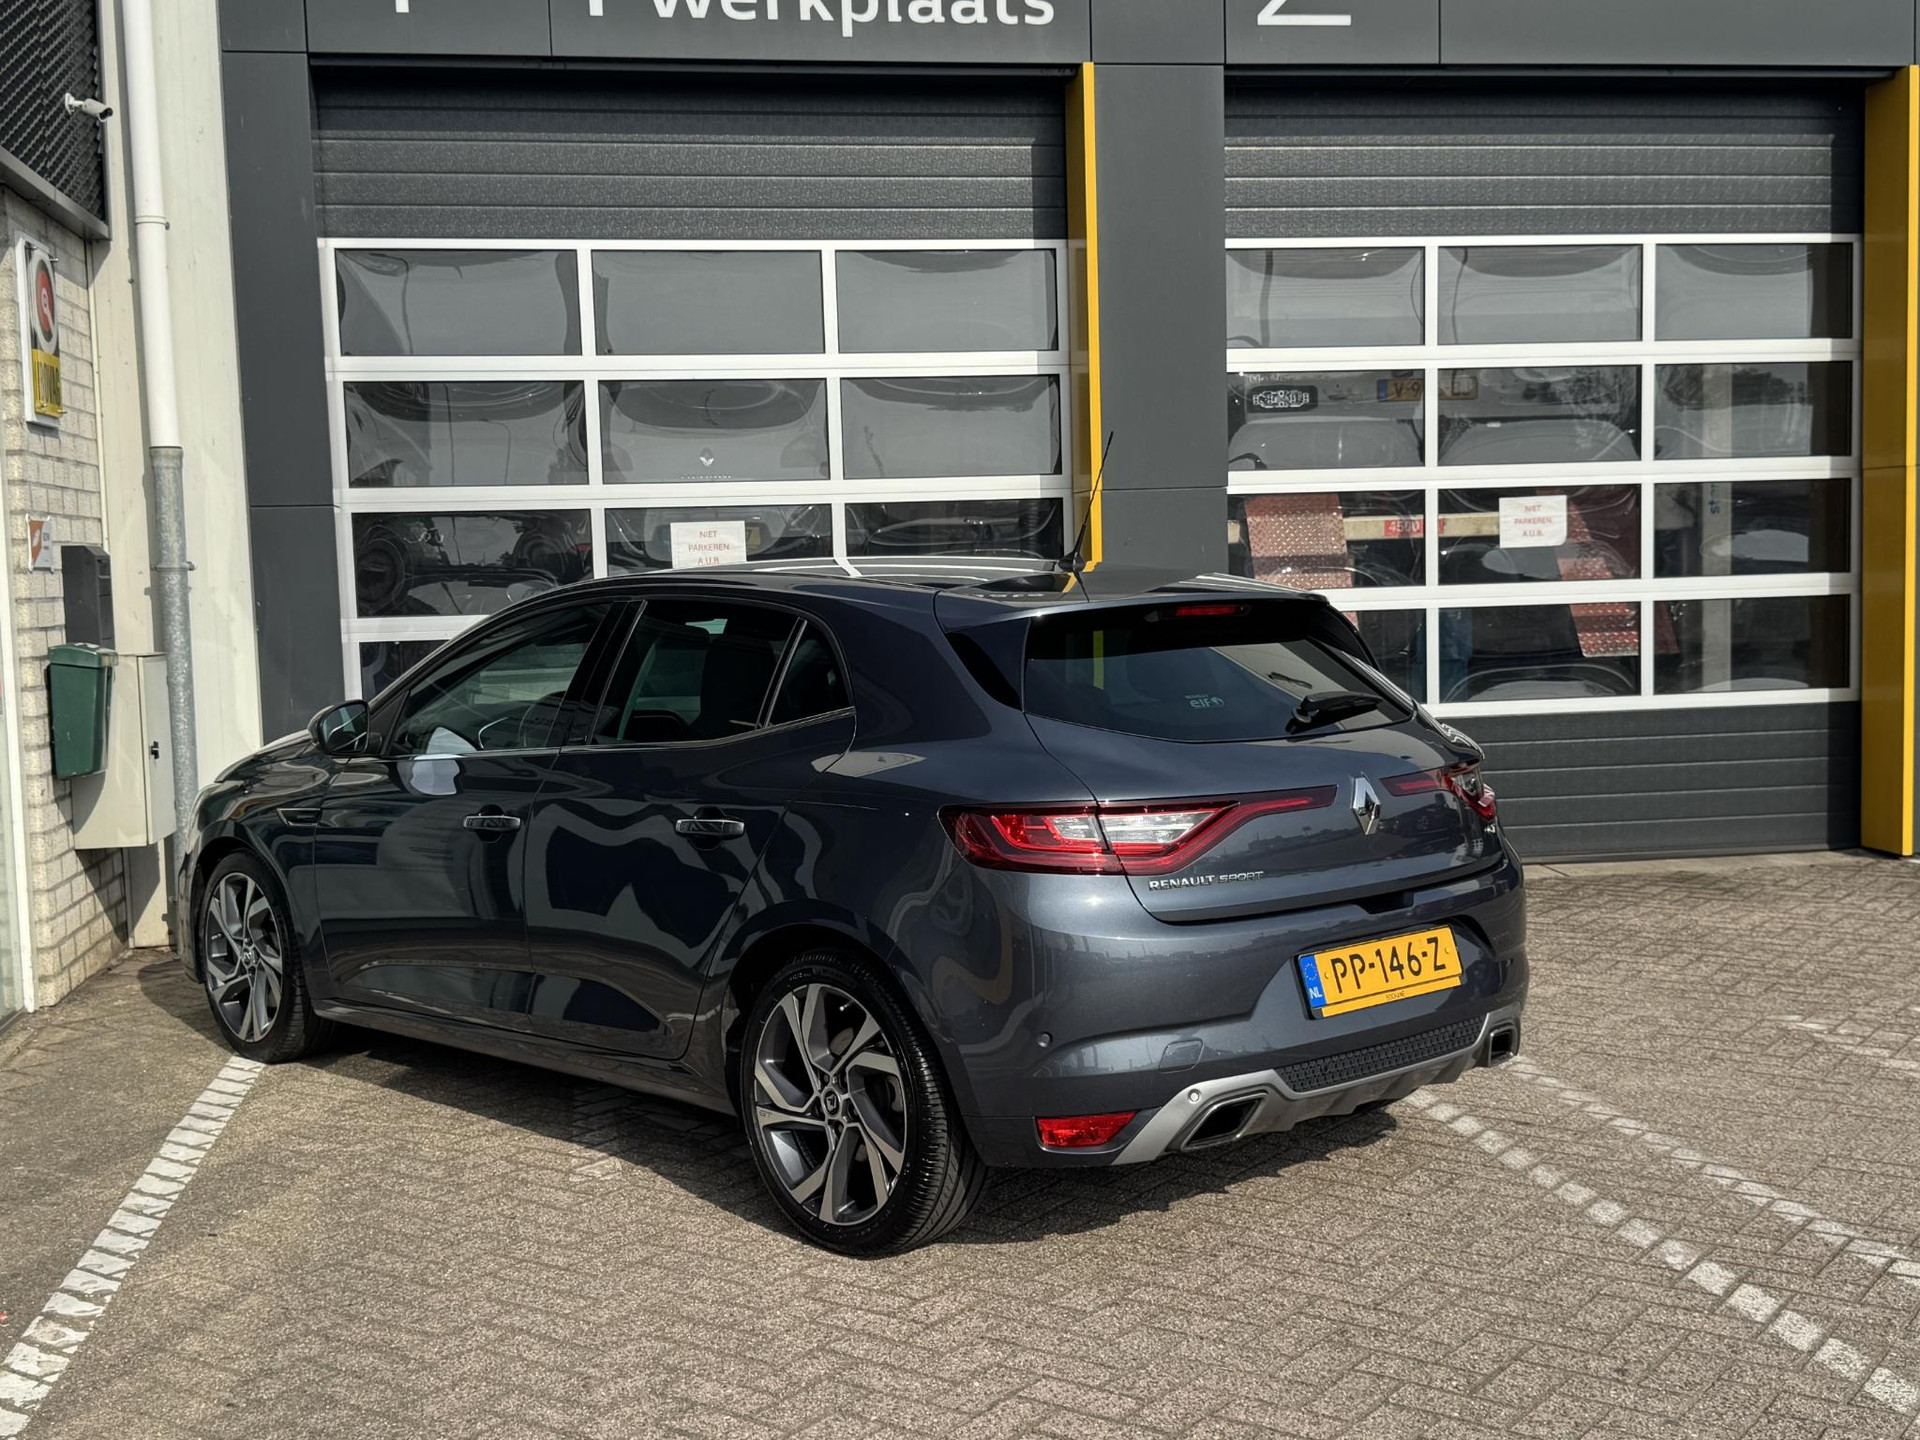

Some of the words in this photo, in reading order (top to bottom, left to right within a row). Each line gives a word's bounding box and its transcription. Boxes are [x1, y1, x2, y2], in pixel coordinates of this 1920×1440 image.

[1524, 504, 1542, 512] NIET
[1514, 516, 1552, 525] PARKEREN
[699, 530, 718, 538] NIET
[688, 543, 730, 552] PARKEREN
[1149, 875, 1215, 891] RENAULT
[1219, 871, 1264, 884] SPORT
[1330, 936, 1446, 994] PP-146-Z
[1309, 987, 1323, 999] NL
